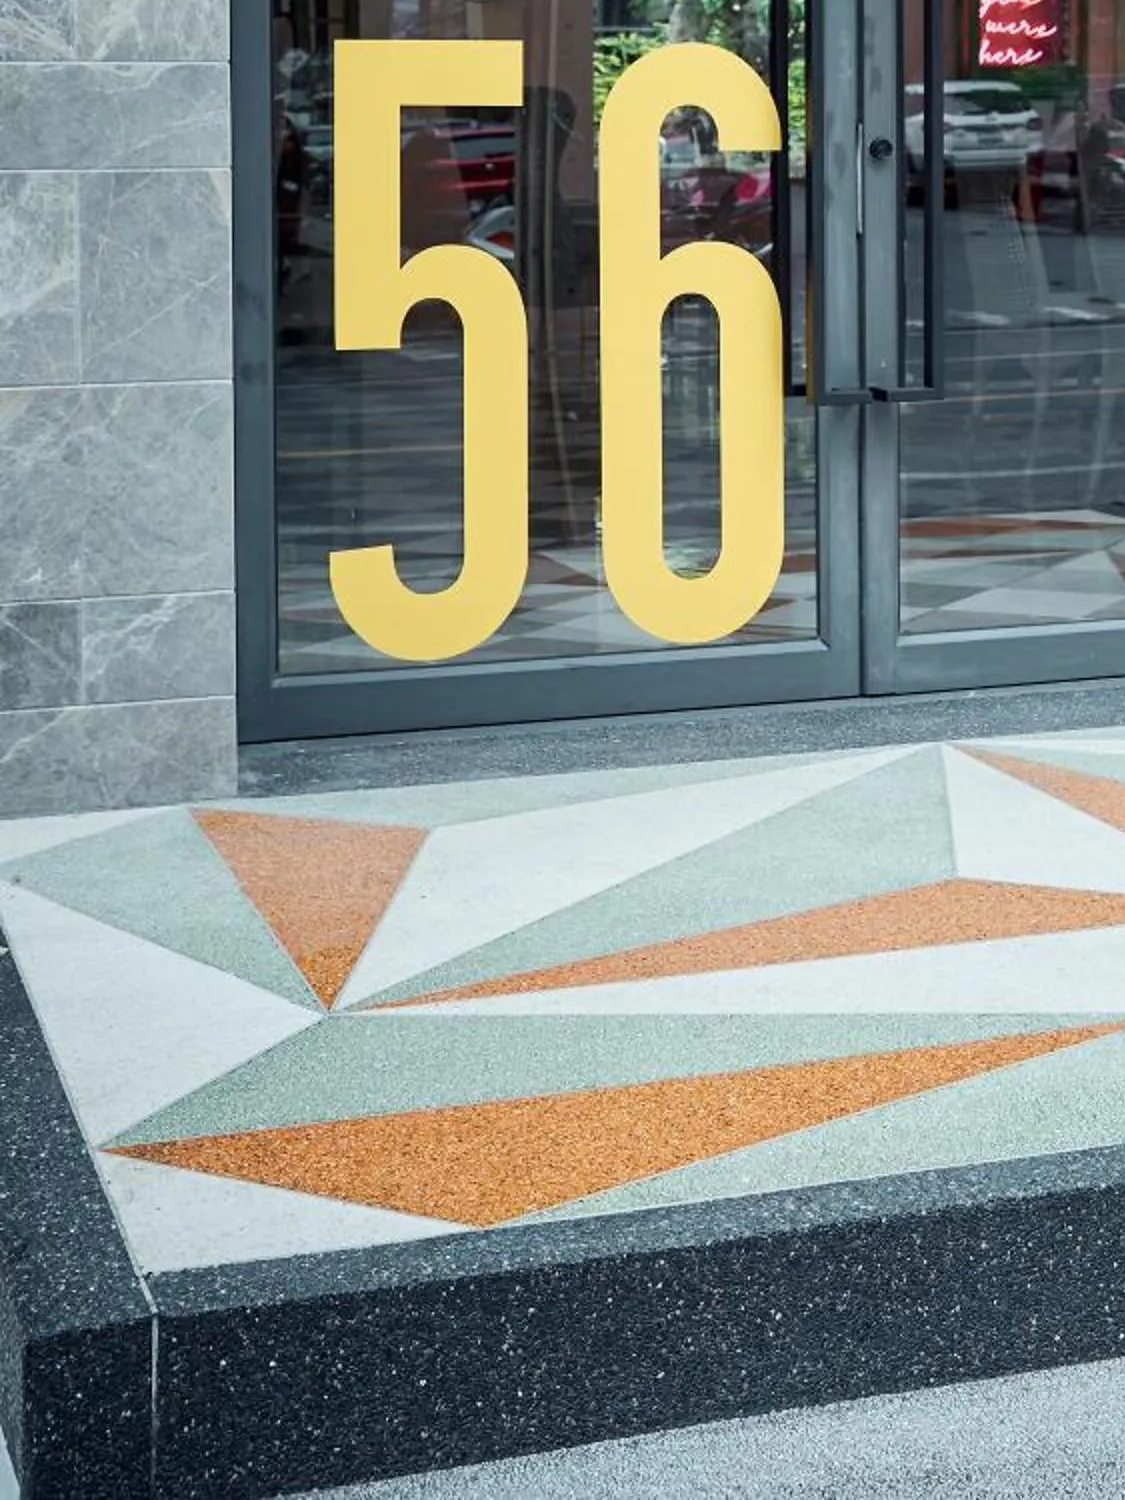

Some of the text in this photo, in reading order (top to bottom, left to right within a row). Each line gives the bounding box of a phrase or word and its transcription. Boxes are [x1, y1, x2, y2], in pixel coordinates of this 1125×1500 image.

[985, 19, 1057, 39] were
[979, 35, 1043, 66] here
[329, 39, 785, 662] 56
